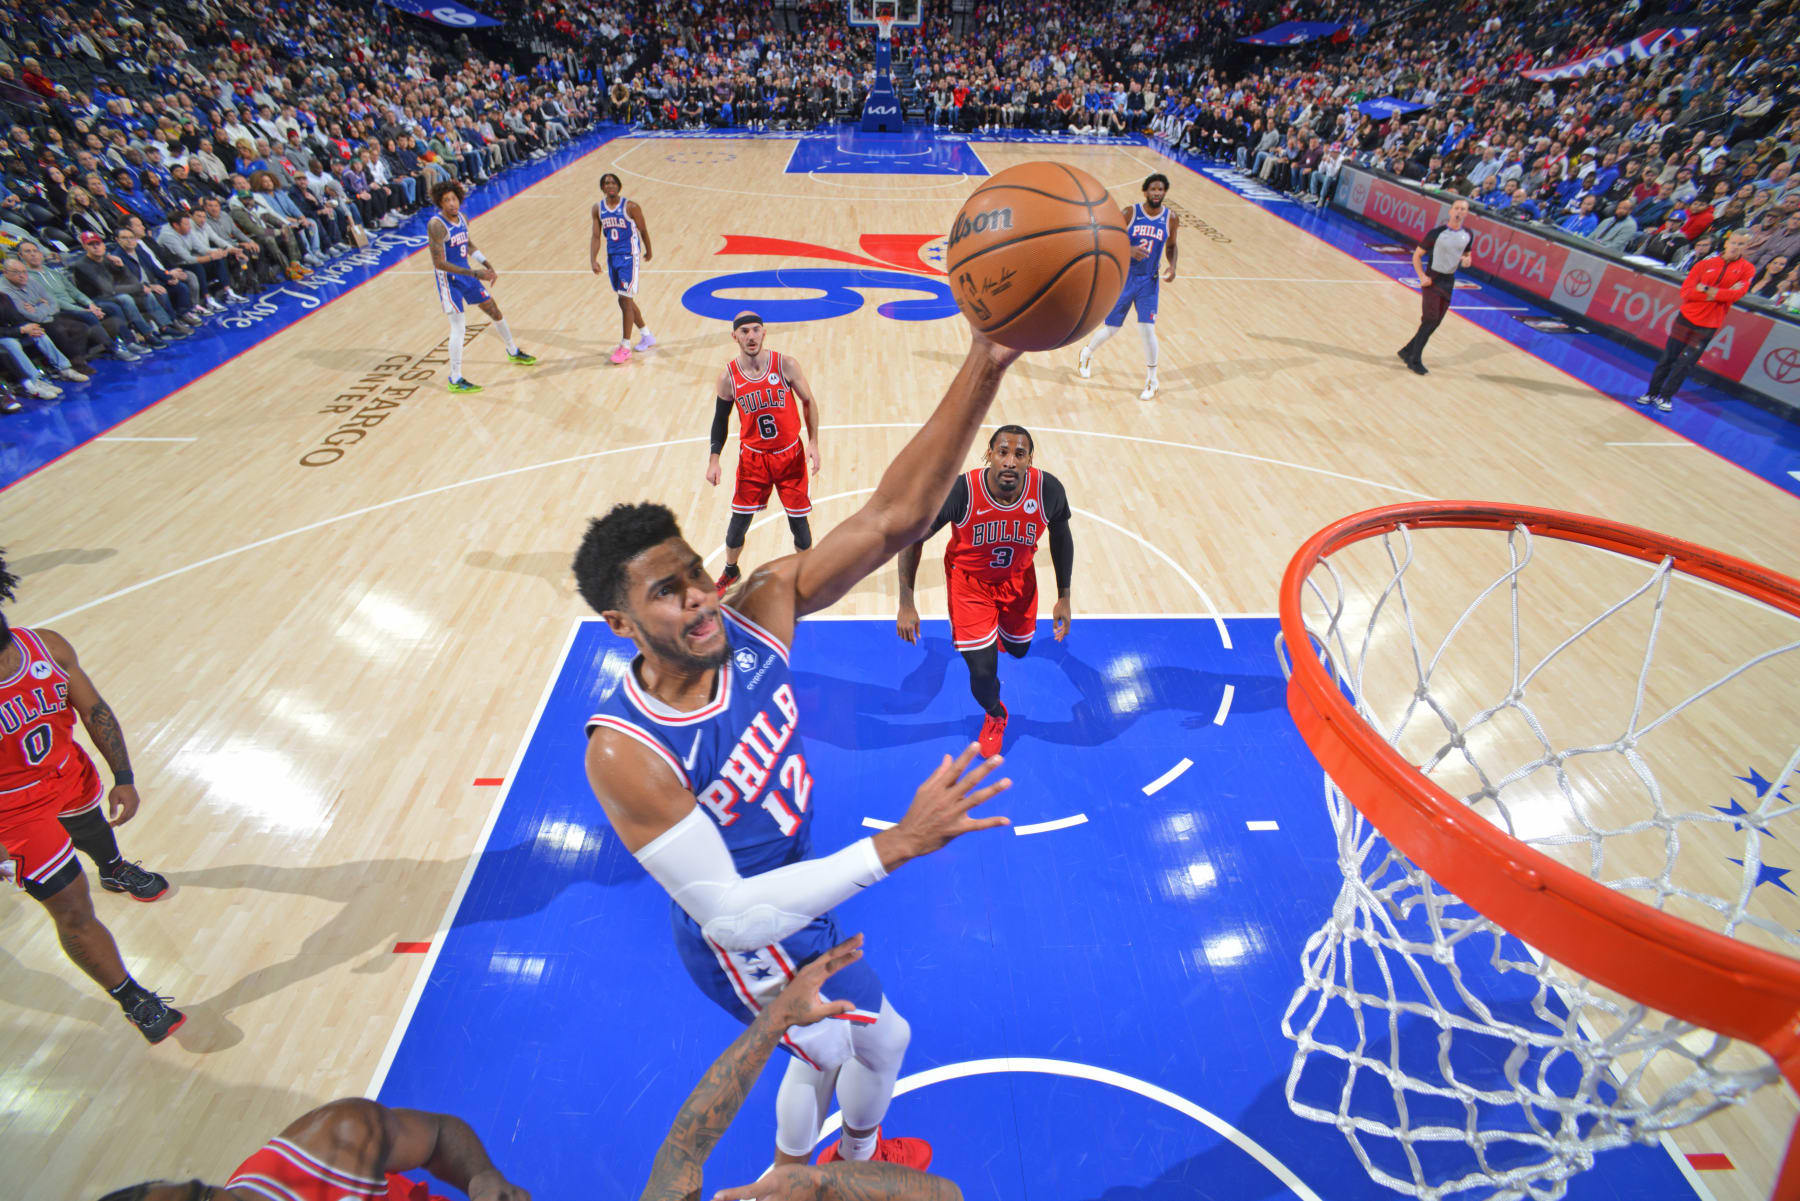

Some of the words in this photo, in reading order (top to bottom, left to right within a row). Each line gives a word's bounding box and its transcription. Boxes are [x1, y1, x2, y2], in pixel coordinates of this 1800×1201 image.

[601, 216, 627, 230] PHILA
[1372, 191, 1427, 233] TOYOTA
[460, 244, 467, 258] 9
[611, 228, 619, 241] 0
[1132, 225, 1164, 241] PHILA
[1139, 238, 1154, 254] 21
[1471, 228, 1547, 284] TOYOTA
[222, 287, 321, 329] Love
[317, 354, 413, 414] CENTER
[737, 388, 786, 415] BULLS
[299, 385, 420, 467] FARGO
[757, 413, 778, 440] 6
[972, 520, 1037, 546] BULLS
[989, 546, 1014, 568] 3
[746, 653, 777, 690] crypto.com
[0, 682, 69, 740] ULLS
[22, 722, 53, 765] 0
[697, 683, 799, 827] PHILA
[761, 753, 814, 837] 12
